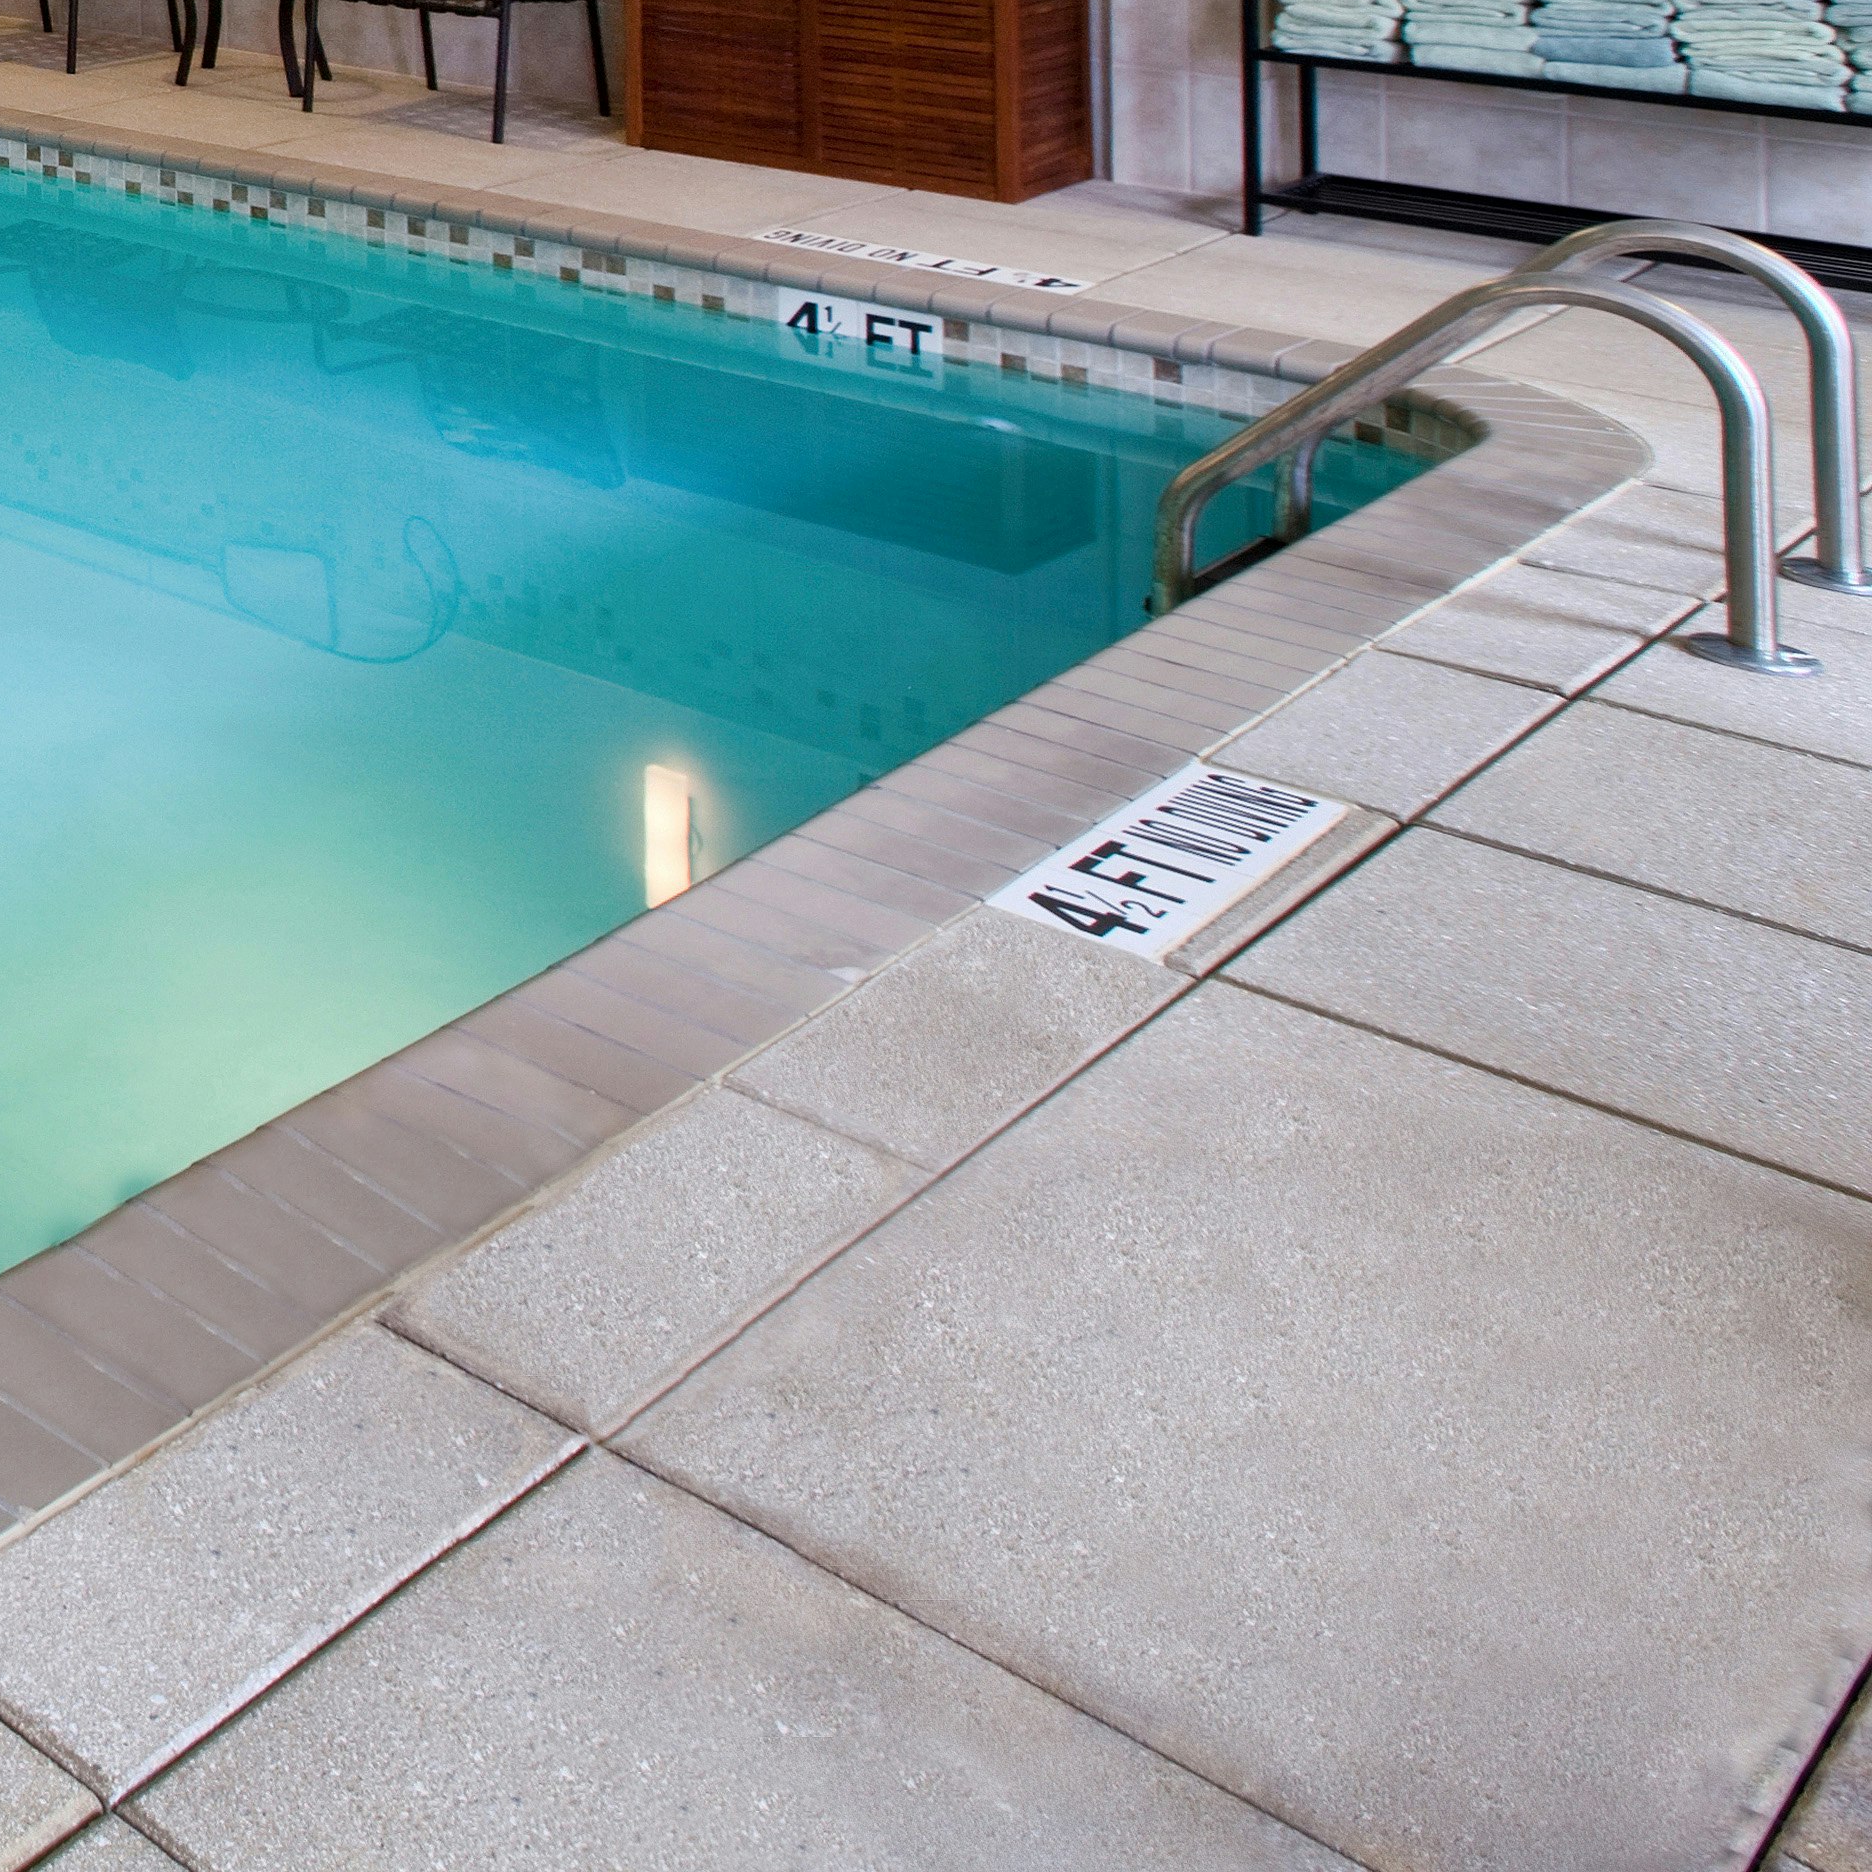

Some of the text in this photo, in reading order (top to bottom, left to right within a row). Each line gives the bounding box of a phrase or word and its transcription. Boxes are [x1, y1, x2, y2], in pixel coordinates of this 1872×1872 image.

[764, 229, 867, 252] DIVING
[868, 249, 920, 262] NO
[917, 259, 1000, 277] FT
[865, 313, 933, 355] FT
[1156, 774, 1319, 842] DIVING
[1122, 818, 1253, 866] NO
[1068, 839, 1218, 904] FT
